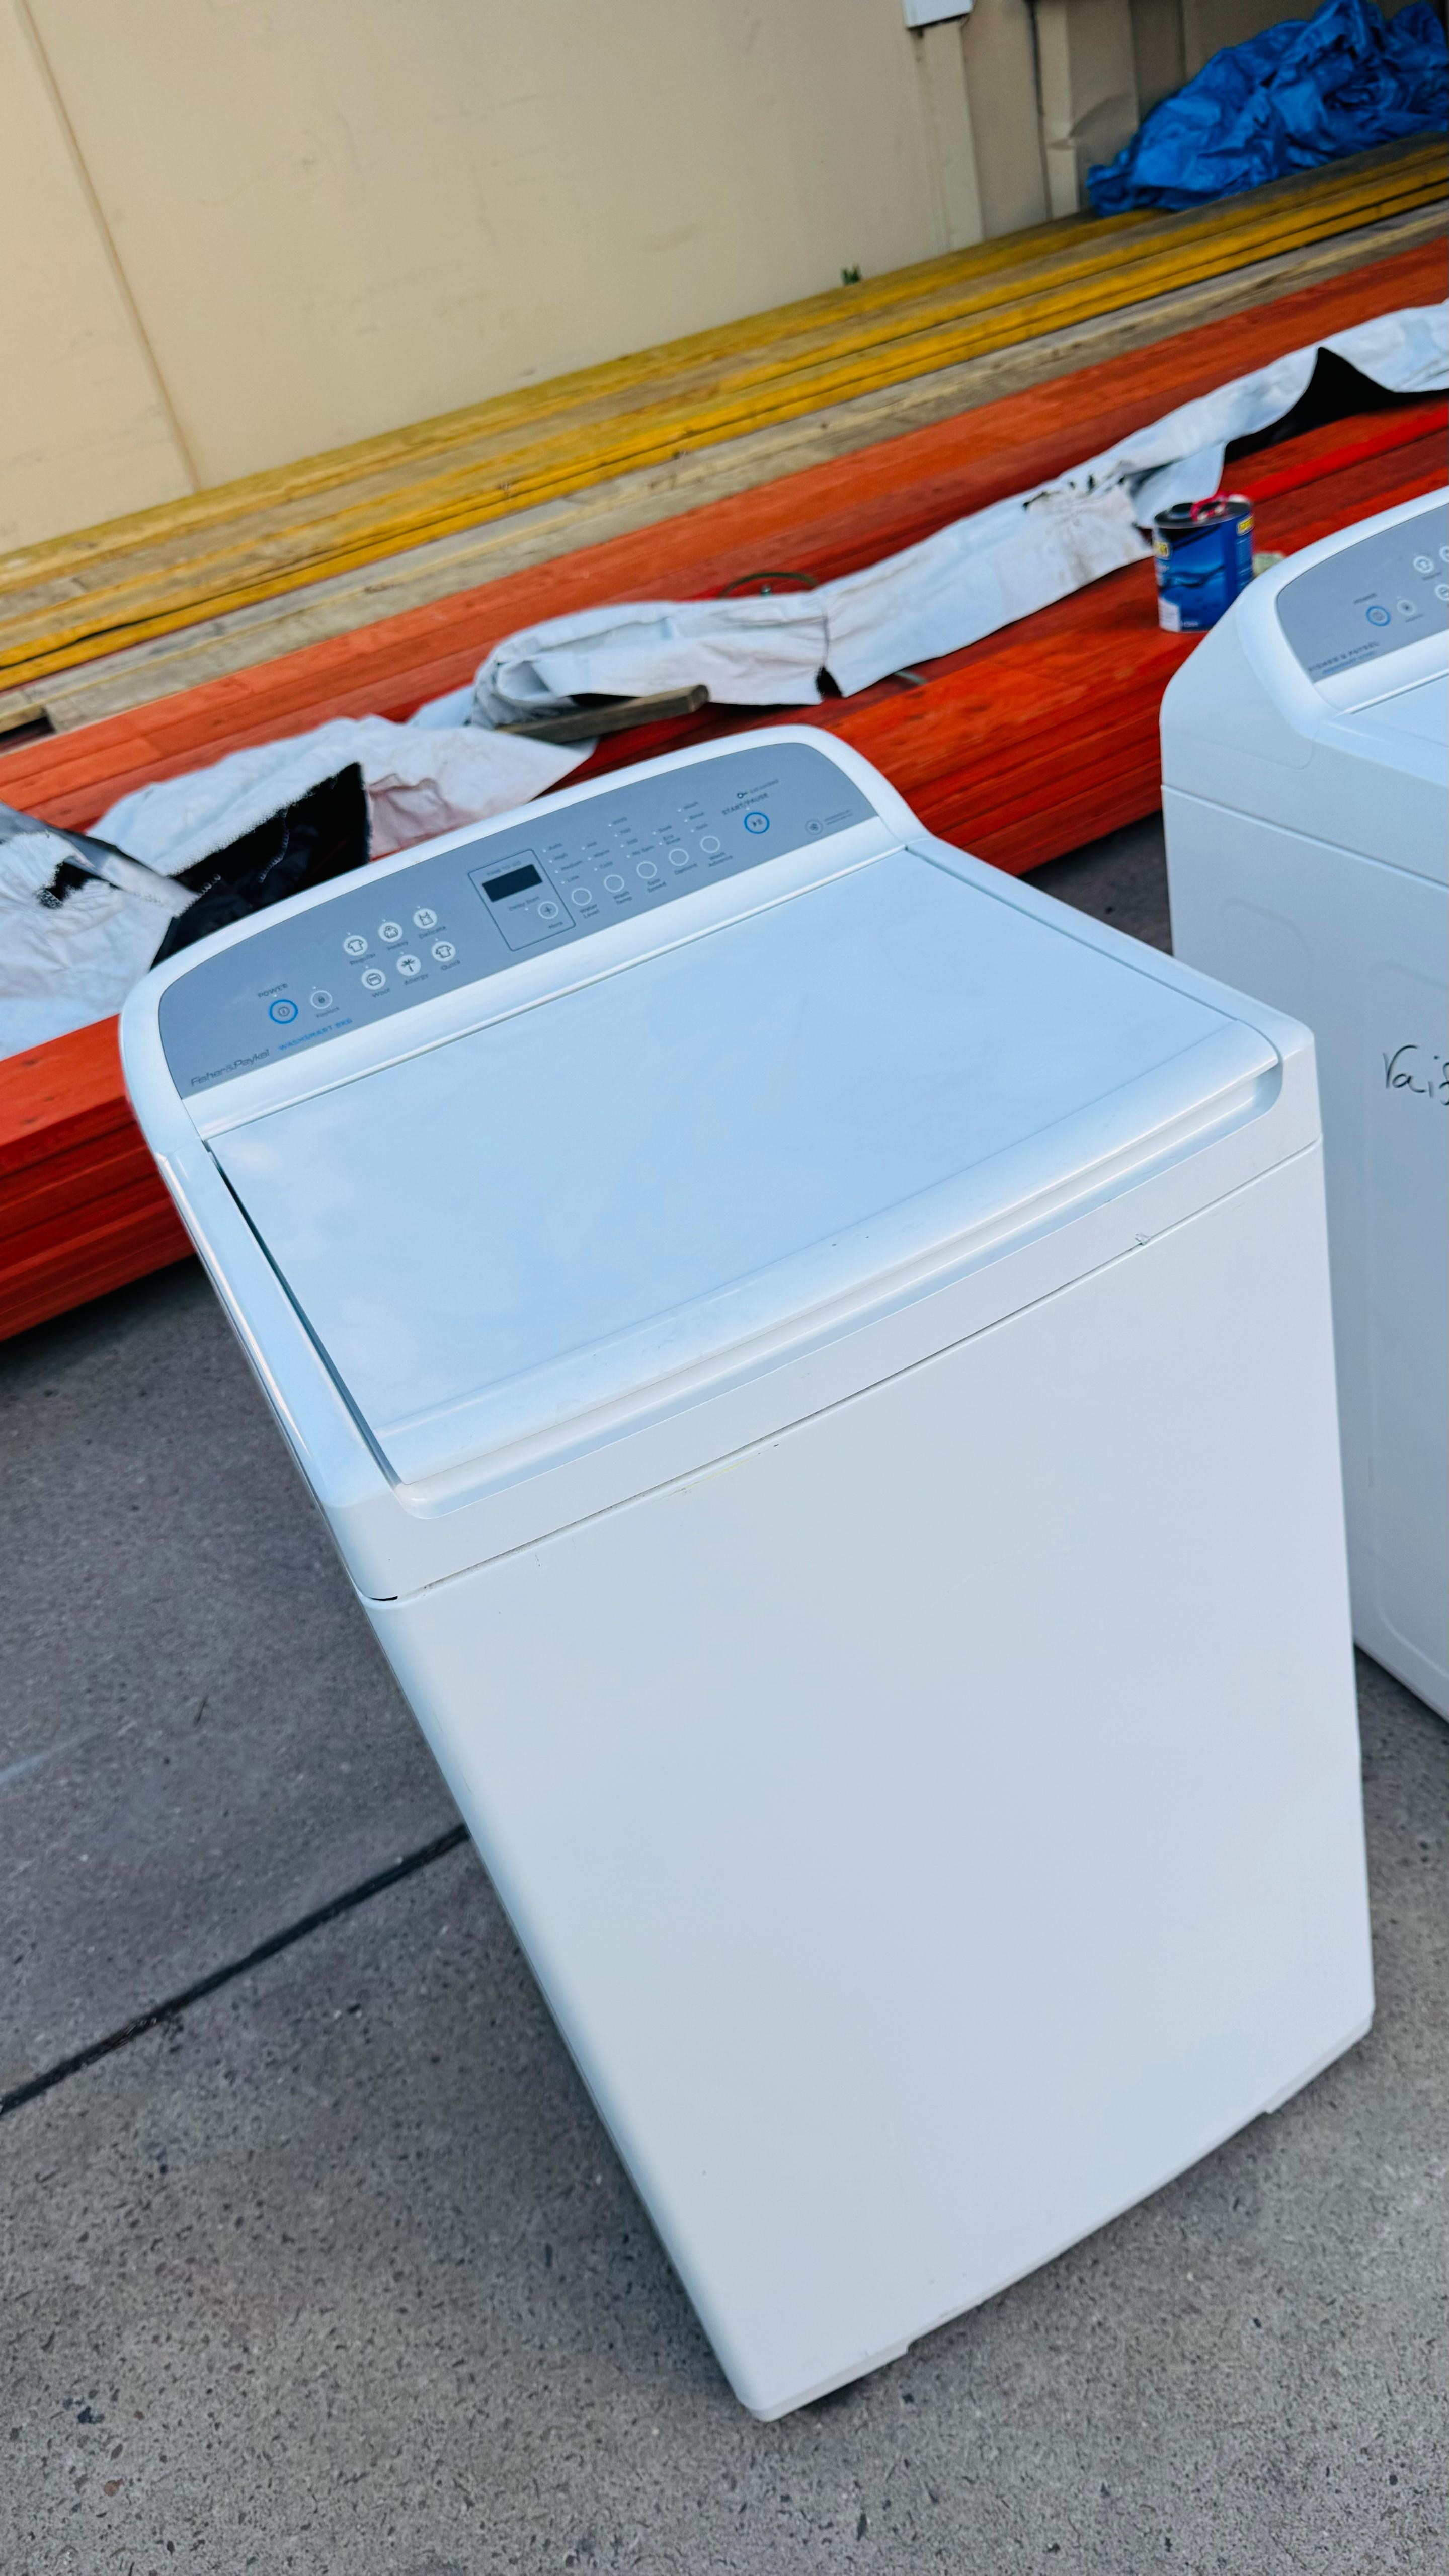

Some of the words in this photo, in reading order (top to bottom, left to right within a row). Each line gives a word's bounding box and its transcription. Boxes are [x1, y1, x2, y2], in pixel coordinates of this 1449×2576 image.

[722, 793, 769, 815] START/PAUSE
[404, 974, 429, 986] Allergy
[257, 983, 288, 998] POWER
[372, 987, 391, 998] Wool
